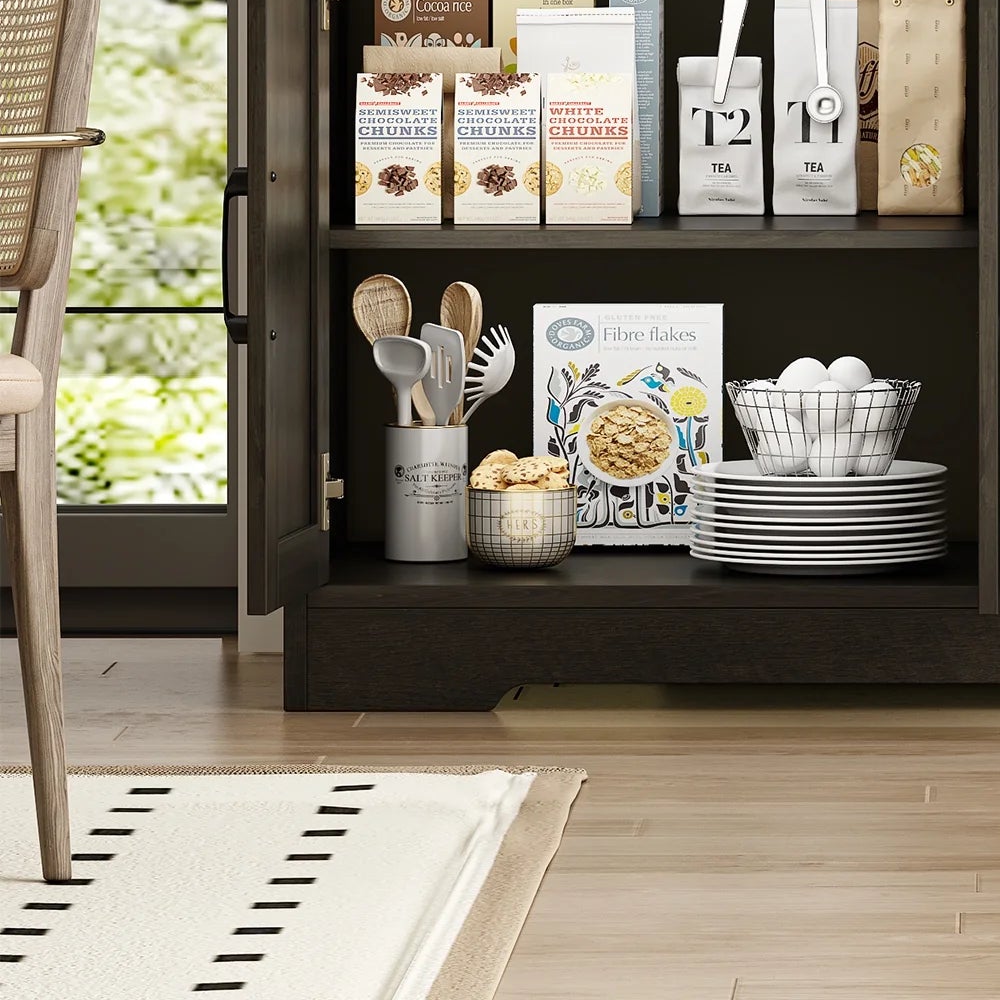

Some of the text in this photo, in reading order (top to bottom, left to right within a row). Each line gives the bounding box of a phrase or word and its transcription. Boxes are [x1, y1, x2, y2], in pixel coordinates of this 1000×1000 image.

[358, 108, 438, 116] SEMISWEET
[457, 108, 537, 116] SEMISWEET
[548, 107, 604, 116] WHITE
[358, 126, 438, 136] CHUNKS
[457, 126, 537, 136] CHUNKS
[548, 126, 629, 136] CHUNKS
[691, 106, 752, 146] T2
[711, 163, 732, 173] TEA
[803, 162, 824, 173] TEA
[549, 319, 592, 338] DOVES FARM
[603, 326, 697, 342] Fibre flakes
[552, 336, 591, 350] ORGANIC
[404, 473, 462, 482] SALT KEEPER
[506, 519, 538, 530] HERS
